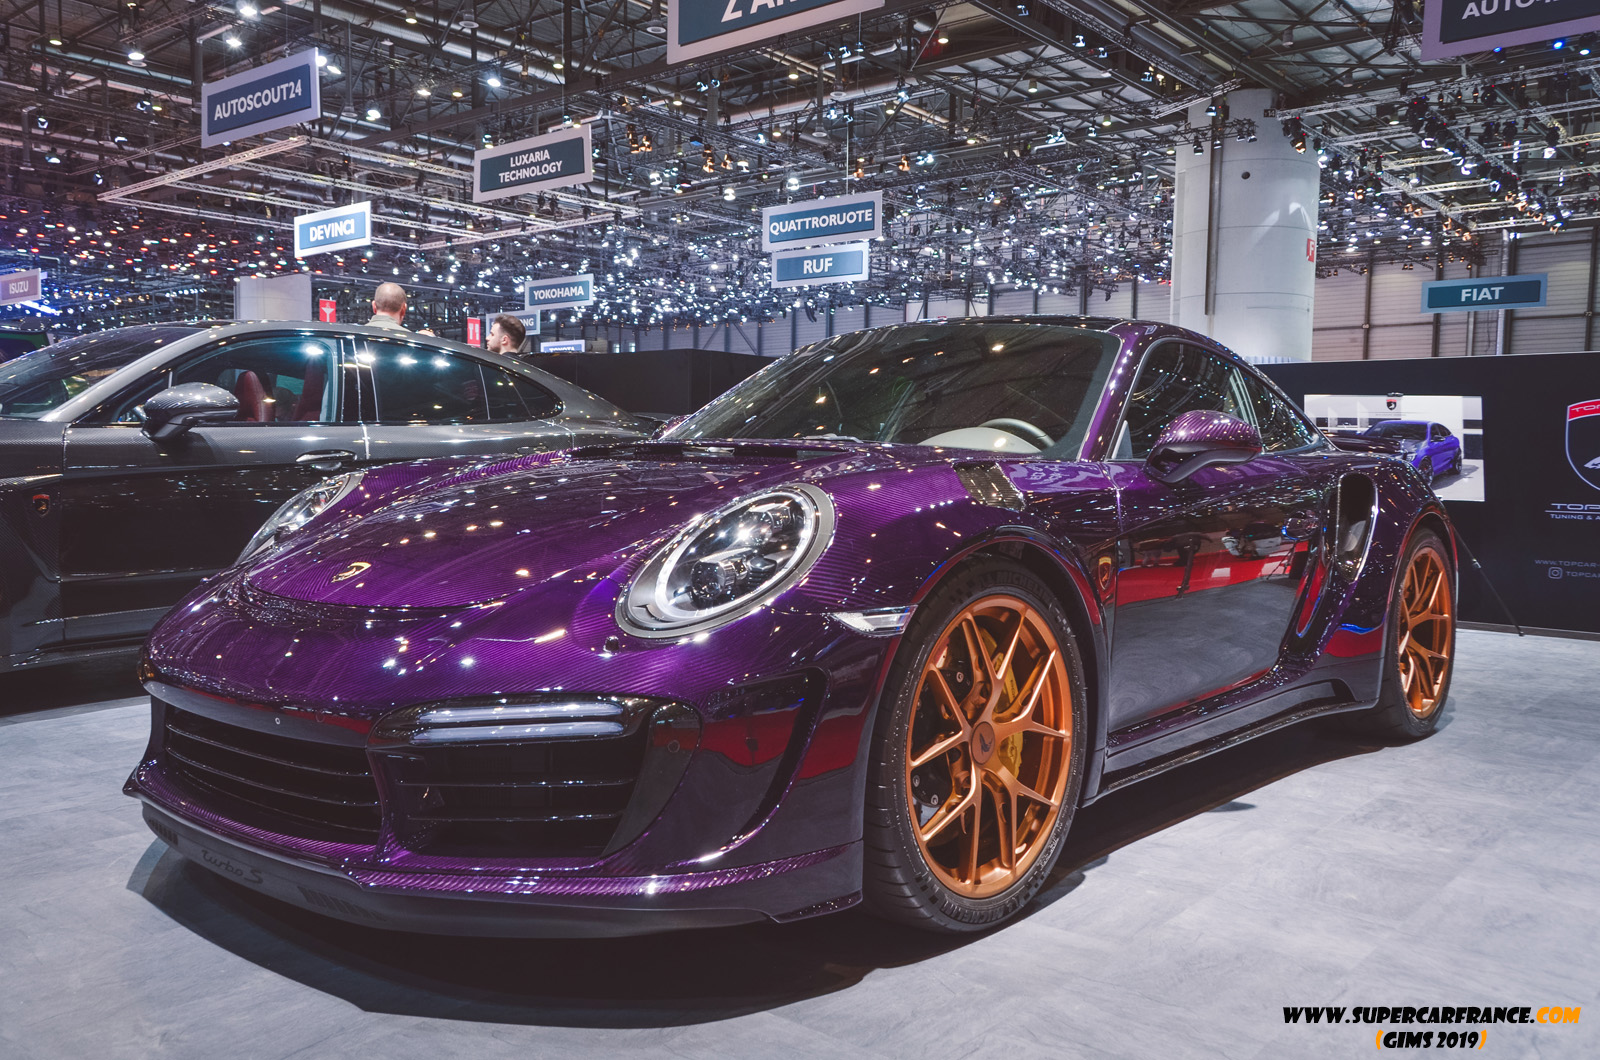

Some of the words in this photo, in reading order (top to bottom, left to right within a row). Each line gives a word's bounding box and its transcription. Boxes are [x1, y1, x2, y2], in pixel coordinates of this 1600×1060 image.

[214, 79, 302, 121] AUTOSCOUT24
[510, 149, 551, 168] LUXARIA
[498, 160, 563, 183] TECHNOLOGY
[309, 218, 355, 242] DEVINCI
[769, 208, 873, 236] QUATTRORUOTE
[803, 257, 833, 274] RUF
[9, 280, 29, 295] ISUZU
[533, 285, 585, 300] YOKOHAMA
[1460, 286, 1505, 302] FIAT
[244, 869, 264, 884] S
